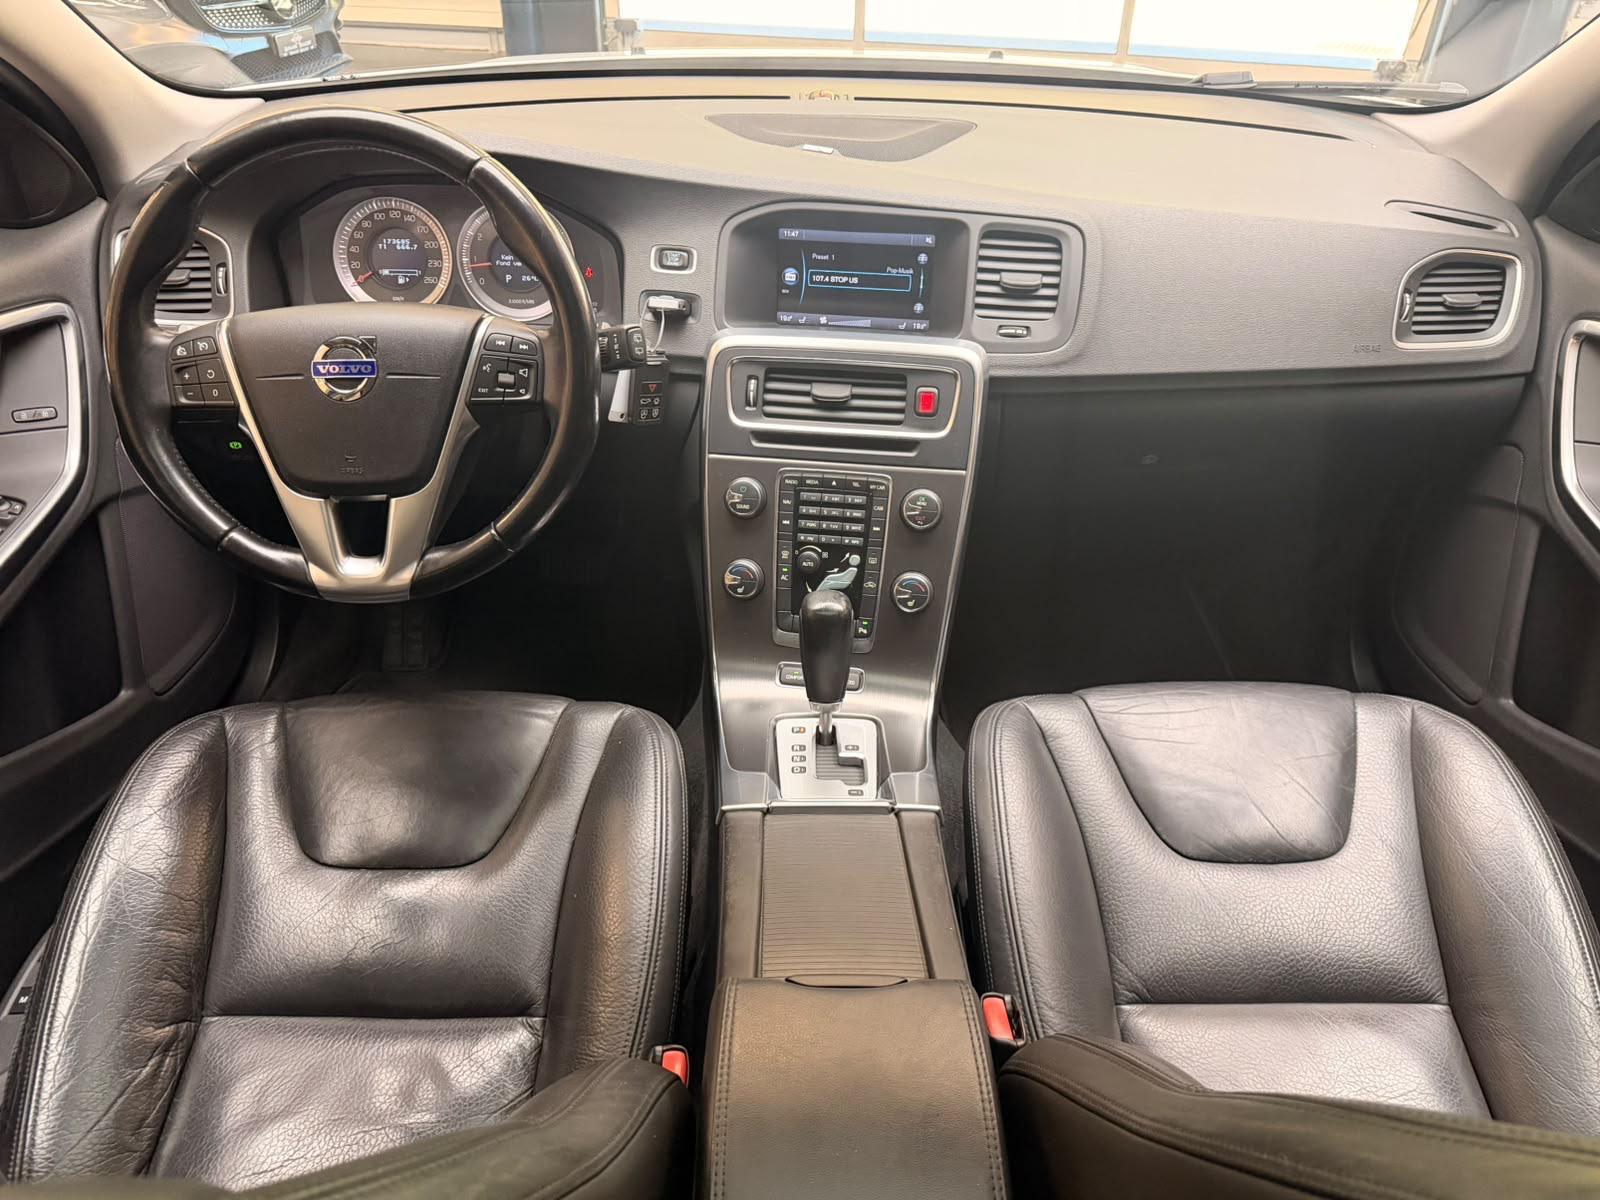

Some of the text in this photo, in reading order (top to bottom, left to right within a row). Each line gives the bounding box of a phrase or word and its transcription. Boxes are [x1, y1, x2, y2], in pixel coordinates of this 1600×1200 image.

[373, 212, 386, 221] 100
[389, 210, 401, 219] 120
[403, 214, 416, 223] 140
[361, 220, 372, 229] 80
[416, 225, 429, 234] 170
[353, 231, 364, 240] 60
[477, 233, 484, 242] 2
[349, 244, 360, 254] 40
[423, 240, 439, 250] 200
[811, 252, 830, 262] Preset
[350, 261, 361, 270] 20
[427, 259, 442, 269] 230
[423, 276, 439, 285] 260
[479, 276, 486, 286] 0
[505, 273, 513, 284] P
[812, 274, 859, 285] 107.4 STOP US
[316, 364, 372, 374] VOLVO
